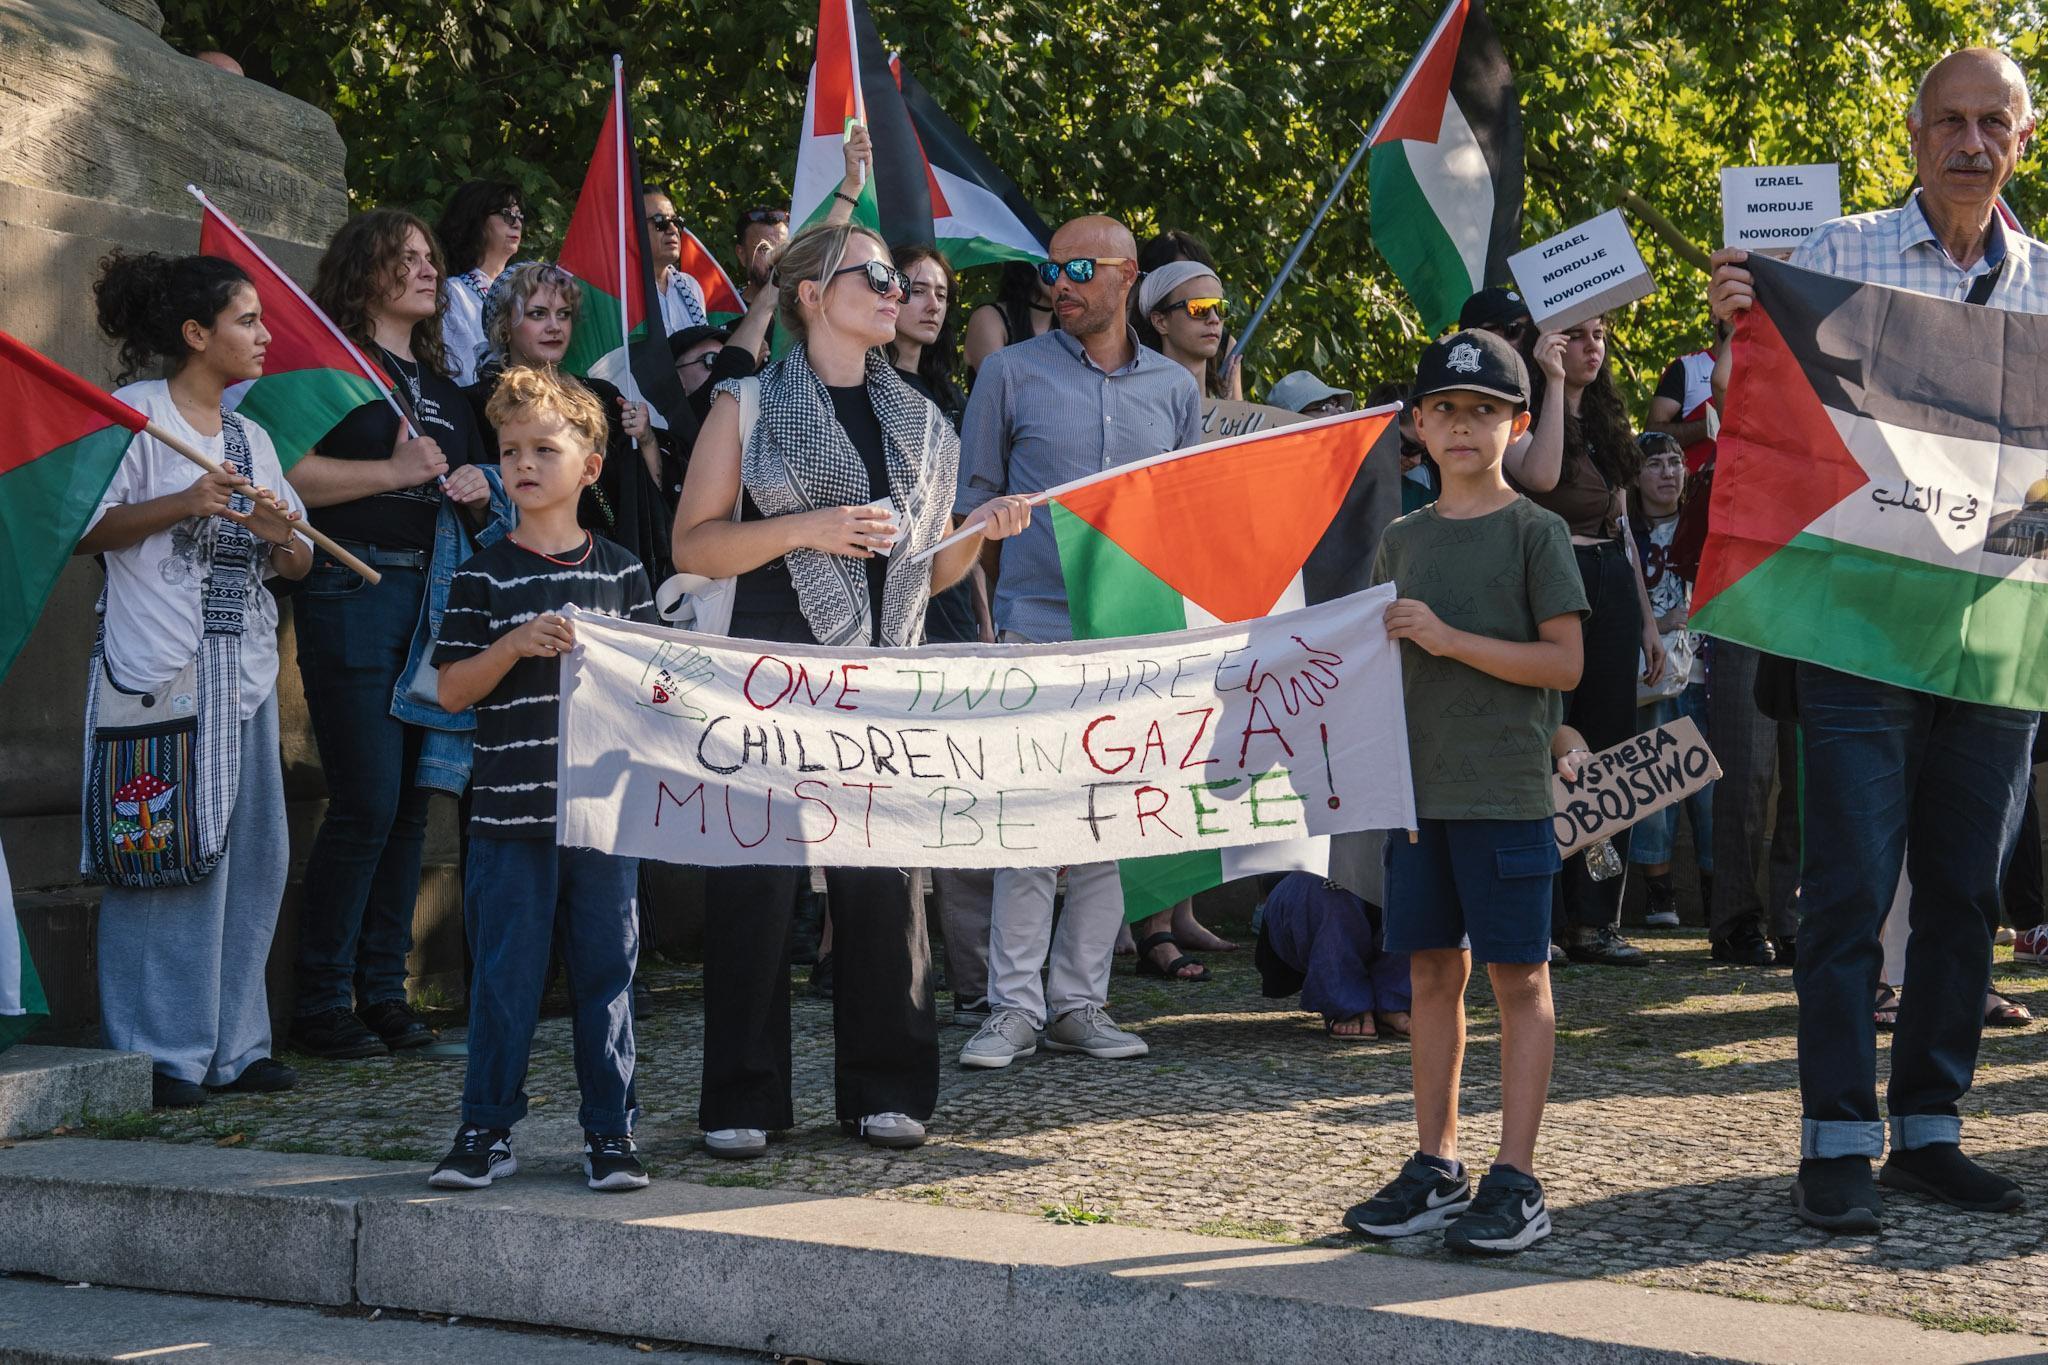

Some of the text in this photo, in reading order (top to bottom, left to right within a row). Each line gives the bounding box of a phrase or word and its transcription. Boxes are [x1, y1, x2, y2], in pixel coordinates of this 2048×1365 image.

[1755, 176, 1804, 188] IZRAEL
[1747, 201, 1814, 214] MORDUJE
[1542, 233, 1590, 260] IZRAEL
[1740, 227, 1815, 240] NOWOROD
[1542, 248, 1608, 284] MORDUJE
[1543, 264, 1626, 308] NOWORODKI
[1871, 479, 1979, 530] في القلب
[743, 645, 1253, 713] ONE TWO THREE
[1082, 696, 1295, 775] GAZA
[654, 779, 892, 849] MUST
[921, 785, 1052, 851] BE
